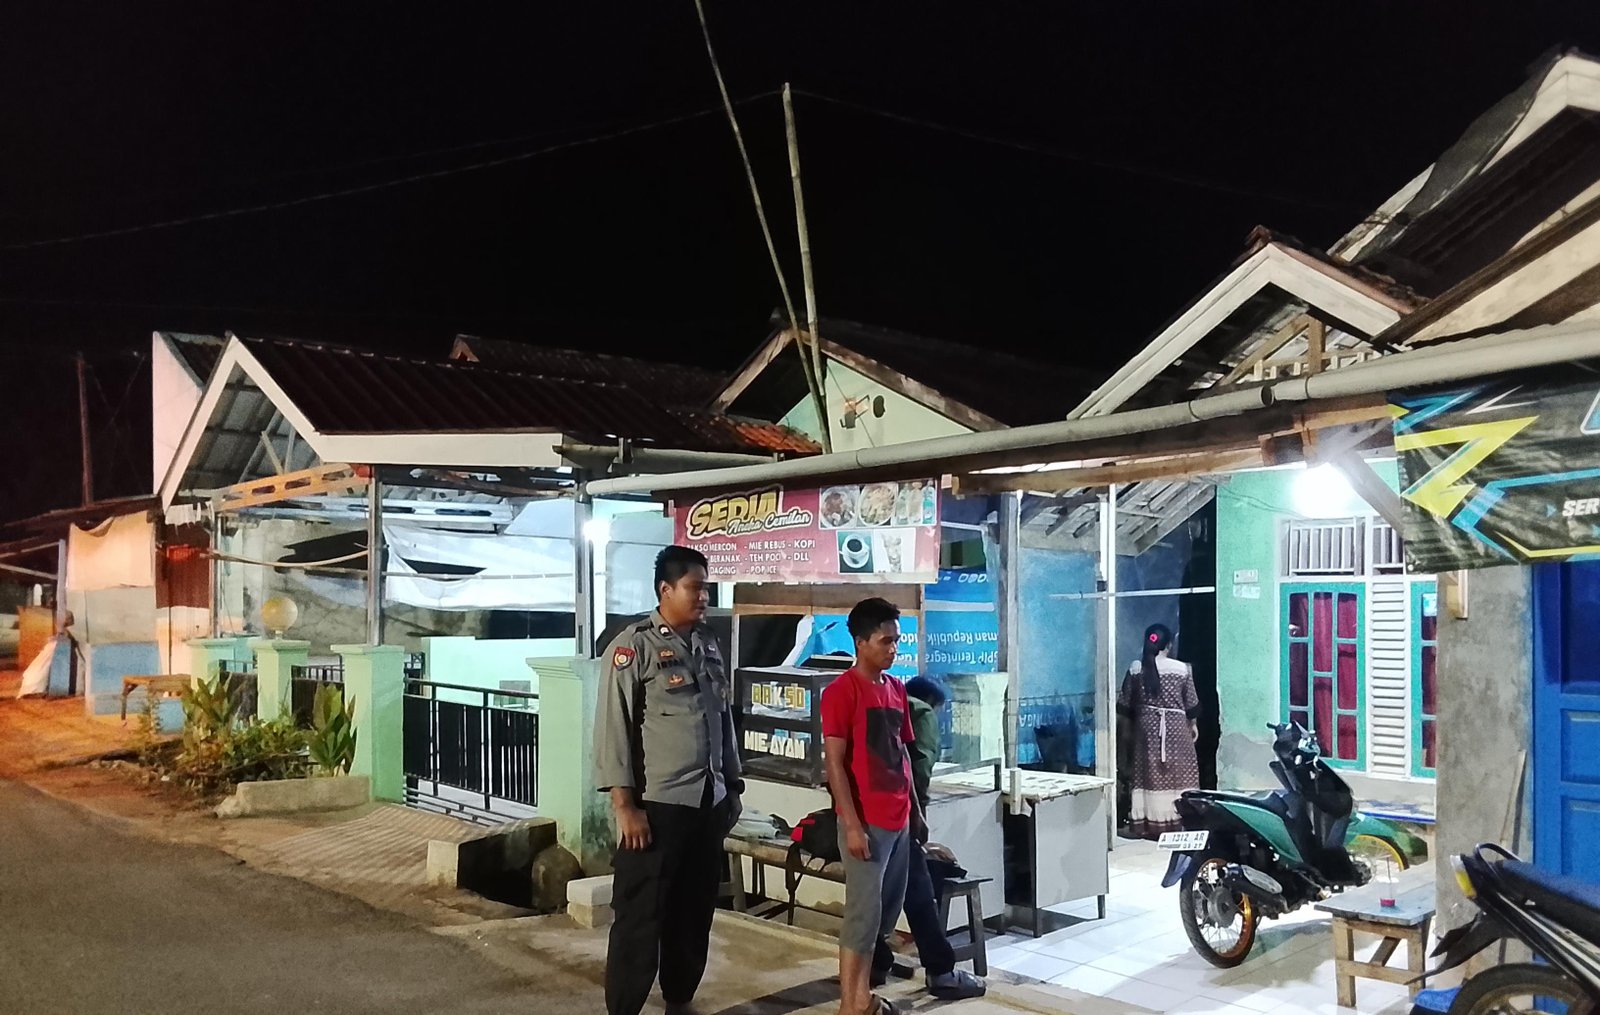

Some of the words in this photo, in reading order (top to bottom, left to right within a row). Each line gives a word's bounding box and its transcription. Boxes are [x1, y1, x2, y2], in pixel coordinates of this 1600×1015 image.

[691, 490, 777, 536] SEDIA
[764, 509, 811, 528] Cemilan
[709, 542, 737, 552] MERCON
[764, 540, 786, 550] REBUS
[793, 539, 815, 548] KOPI
[710, 554, 741, 563] BERANAK
[749, 553, 763, 562] TEH
[793, 552, 809, 561] DLL
[709, 566, 736, 575] DAGING
[750, 565, 765, 574] POP
[927, 630, 973, 645] Republik
[925, 651, 976, 665] Terintegra
[744, 730, 768, 752] MIE
[769, 735, 806, 760] AYAM
